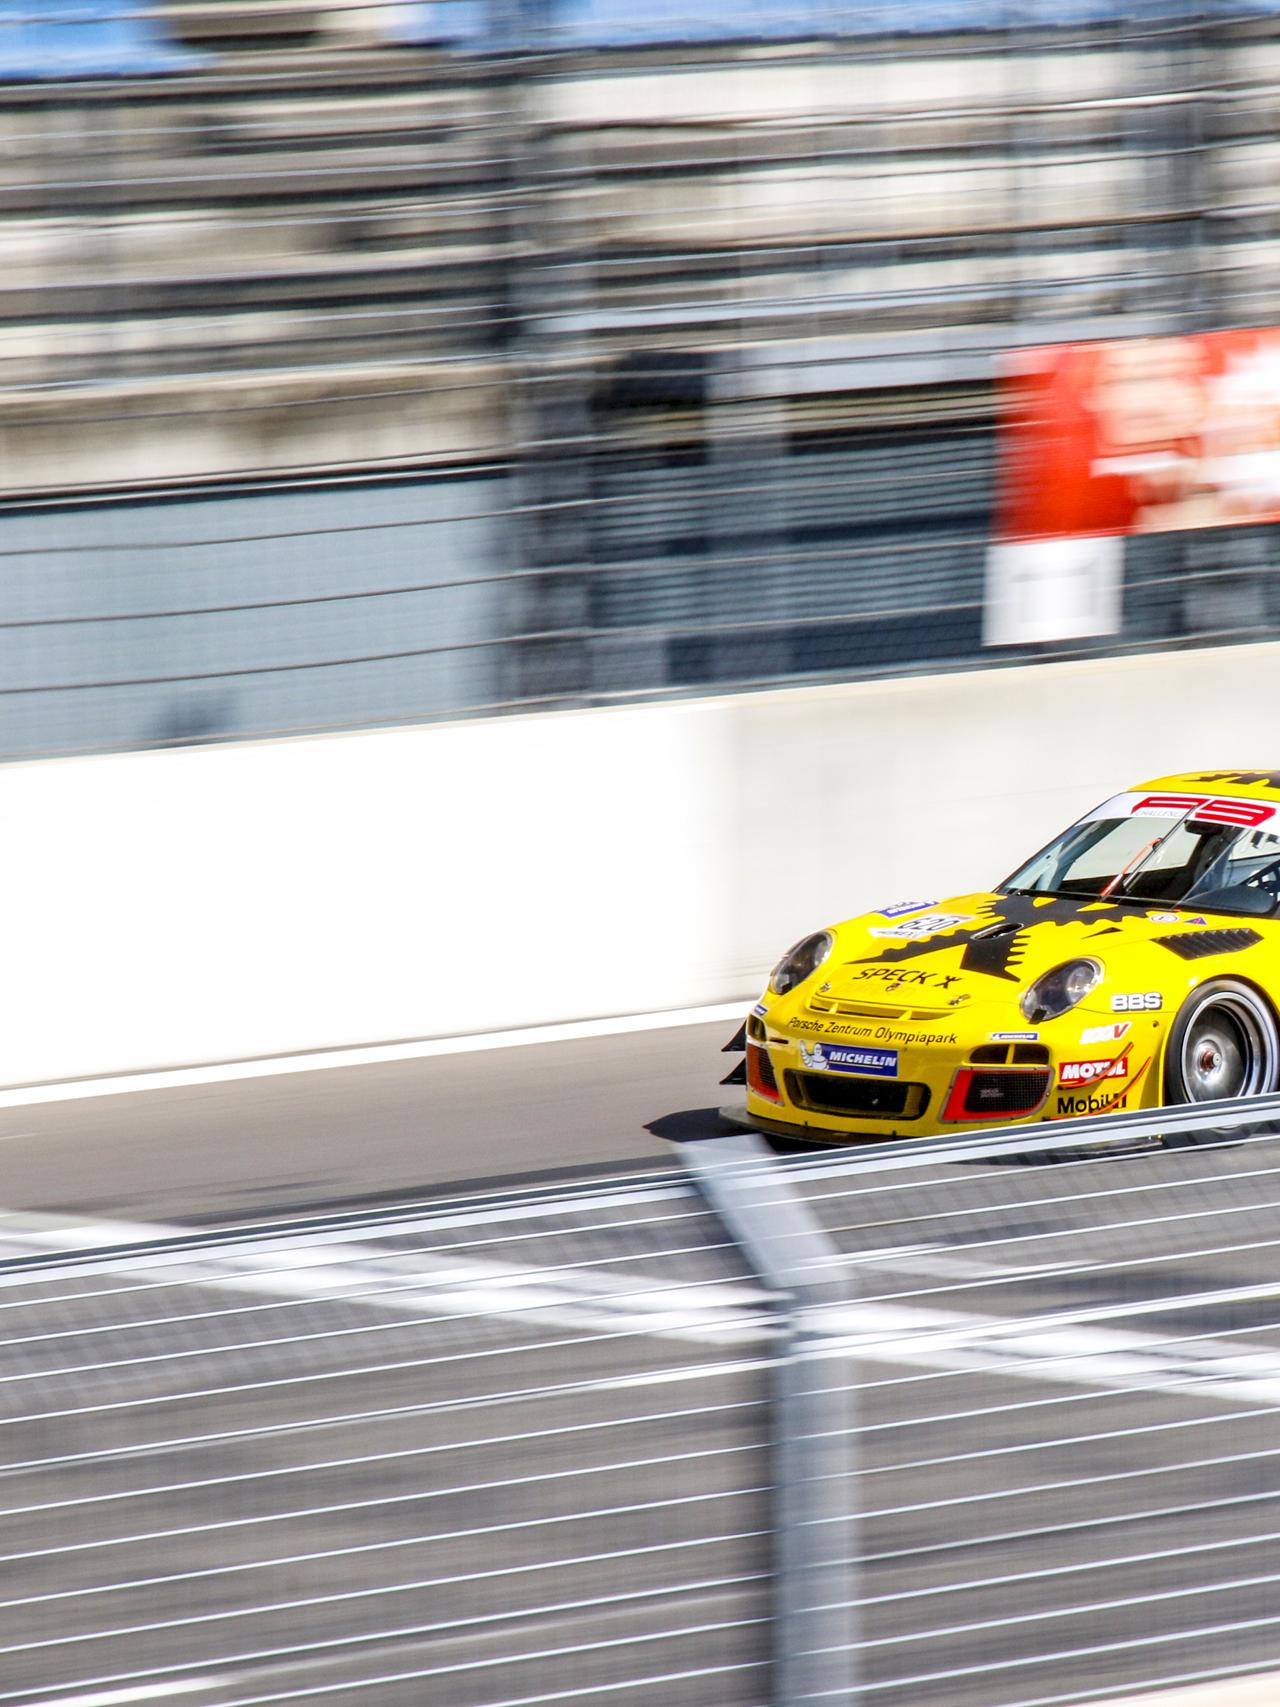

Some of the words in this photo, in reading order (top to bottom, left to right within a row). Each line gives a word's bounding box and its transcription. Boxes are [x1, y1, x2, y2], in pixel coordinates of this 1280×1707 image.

[897, 917, 961, 932] 620
[852, 968, 938, 985] SPECK
[1111, 992, 1163, 1012] BBS
[787, 1016, 824, 1032] Porsche
[824, 1022, 873, 1038] Zentrum
[875, 1027, 958, 1045] Olympiapark
[829, 1051, 897, 1067] MICHELIN
